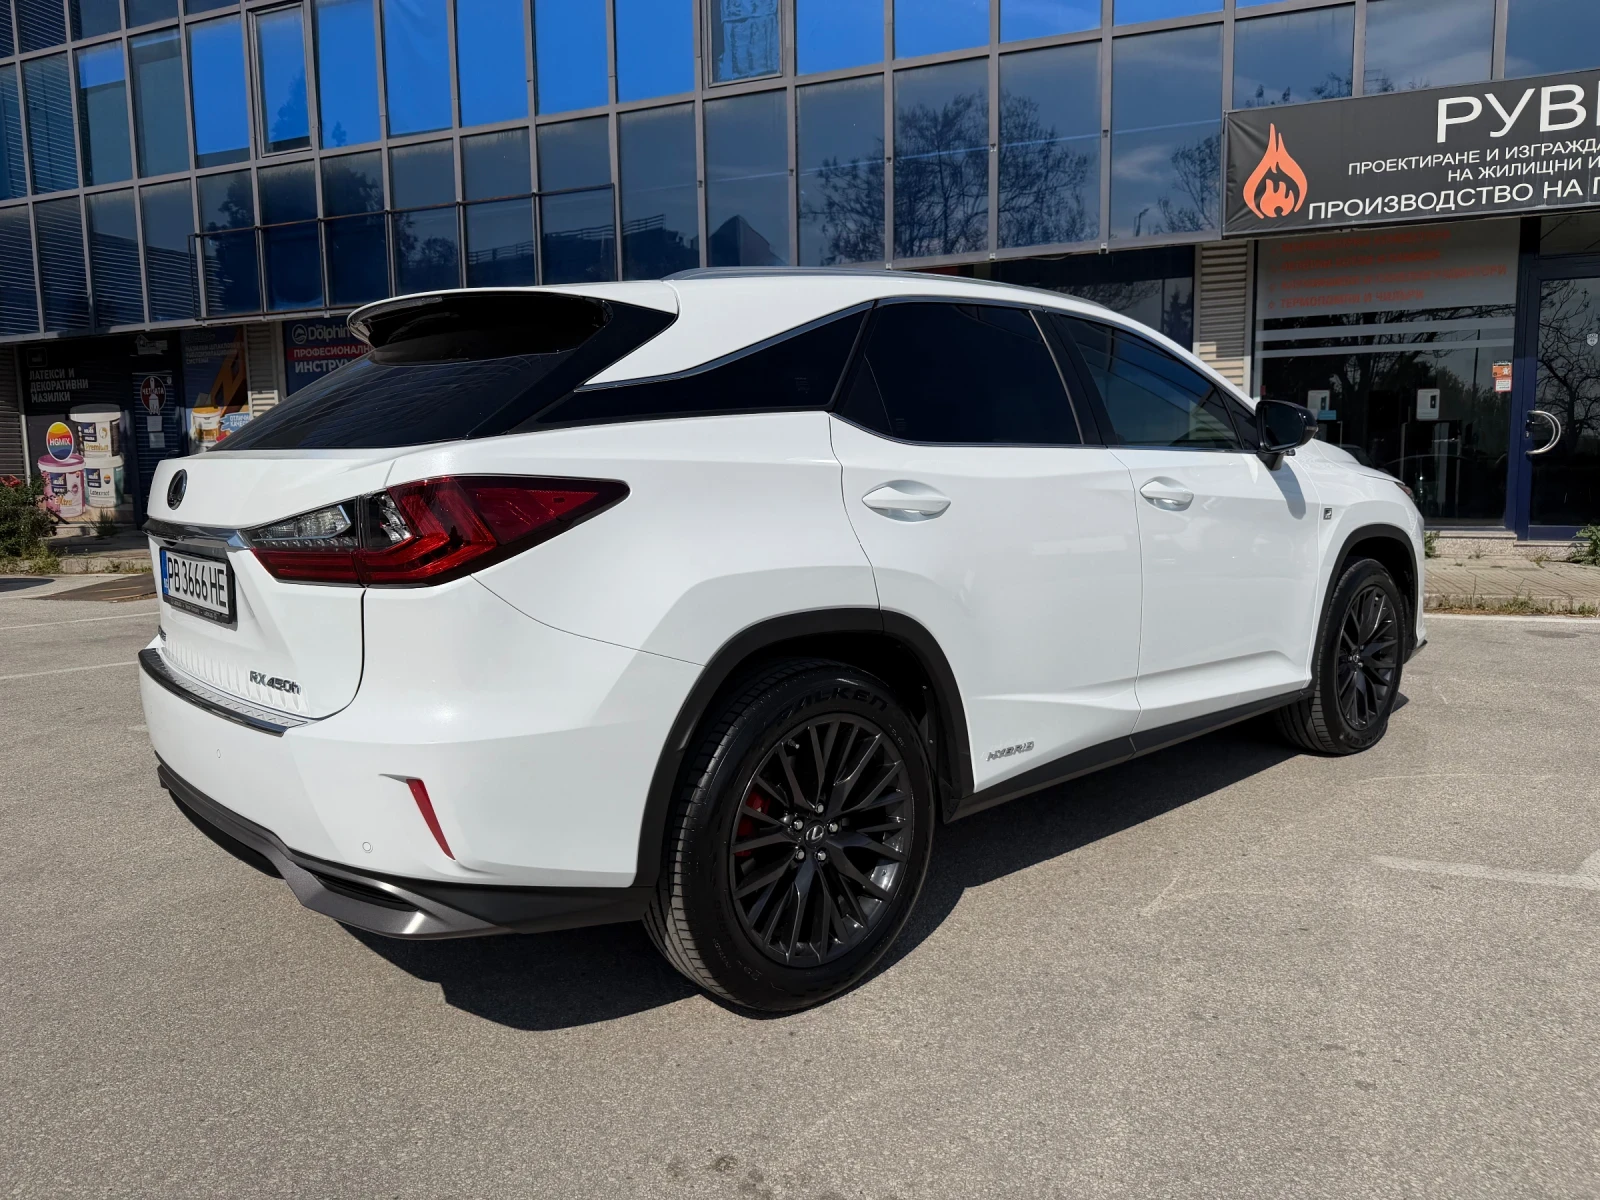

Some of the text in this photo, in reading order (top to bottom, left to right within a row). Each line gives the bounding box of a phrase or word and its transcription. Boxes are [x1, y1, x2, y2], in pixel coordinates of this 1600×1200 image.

[1348, 137, 1600, 176] ПРОЕКТИРАНЕ И ИЗГРАЖД
[1447, 168, 1474, 182] НА
[1478, 157, 1582, 180] ЖИЛИЩНИ
[1308, 183, 1534, 220] ПРОИЗВОДСТВО
[1543, 178, 1584, 199] НА
[308, 324, 350, 342] Dolphin
[293, 344, 373, 358] ПРОФЕСИОНАЛН
[29, 367, 75, 381] ЛАТЕКСИ И
[294, 358, 351, 373] ИНСТРУ
[30, 378, 89, 394] ДЕКОРАТИВНИ
[31, 391, 71, 404] МАЗИЛКИ
[49, 437, 71, 447] HGMIX
[168, 557, 227, 608] PB 3666 HE
[250, 670, 302, 695] RX 450h
[986, 741, 1034, 762] HYBRID
